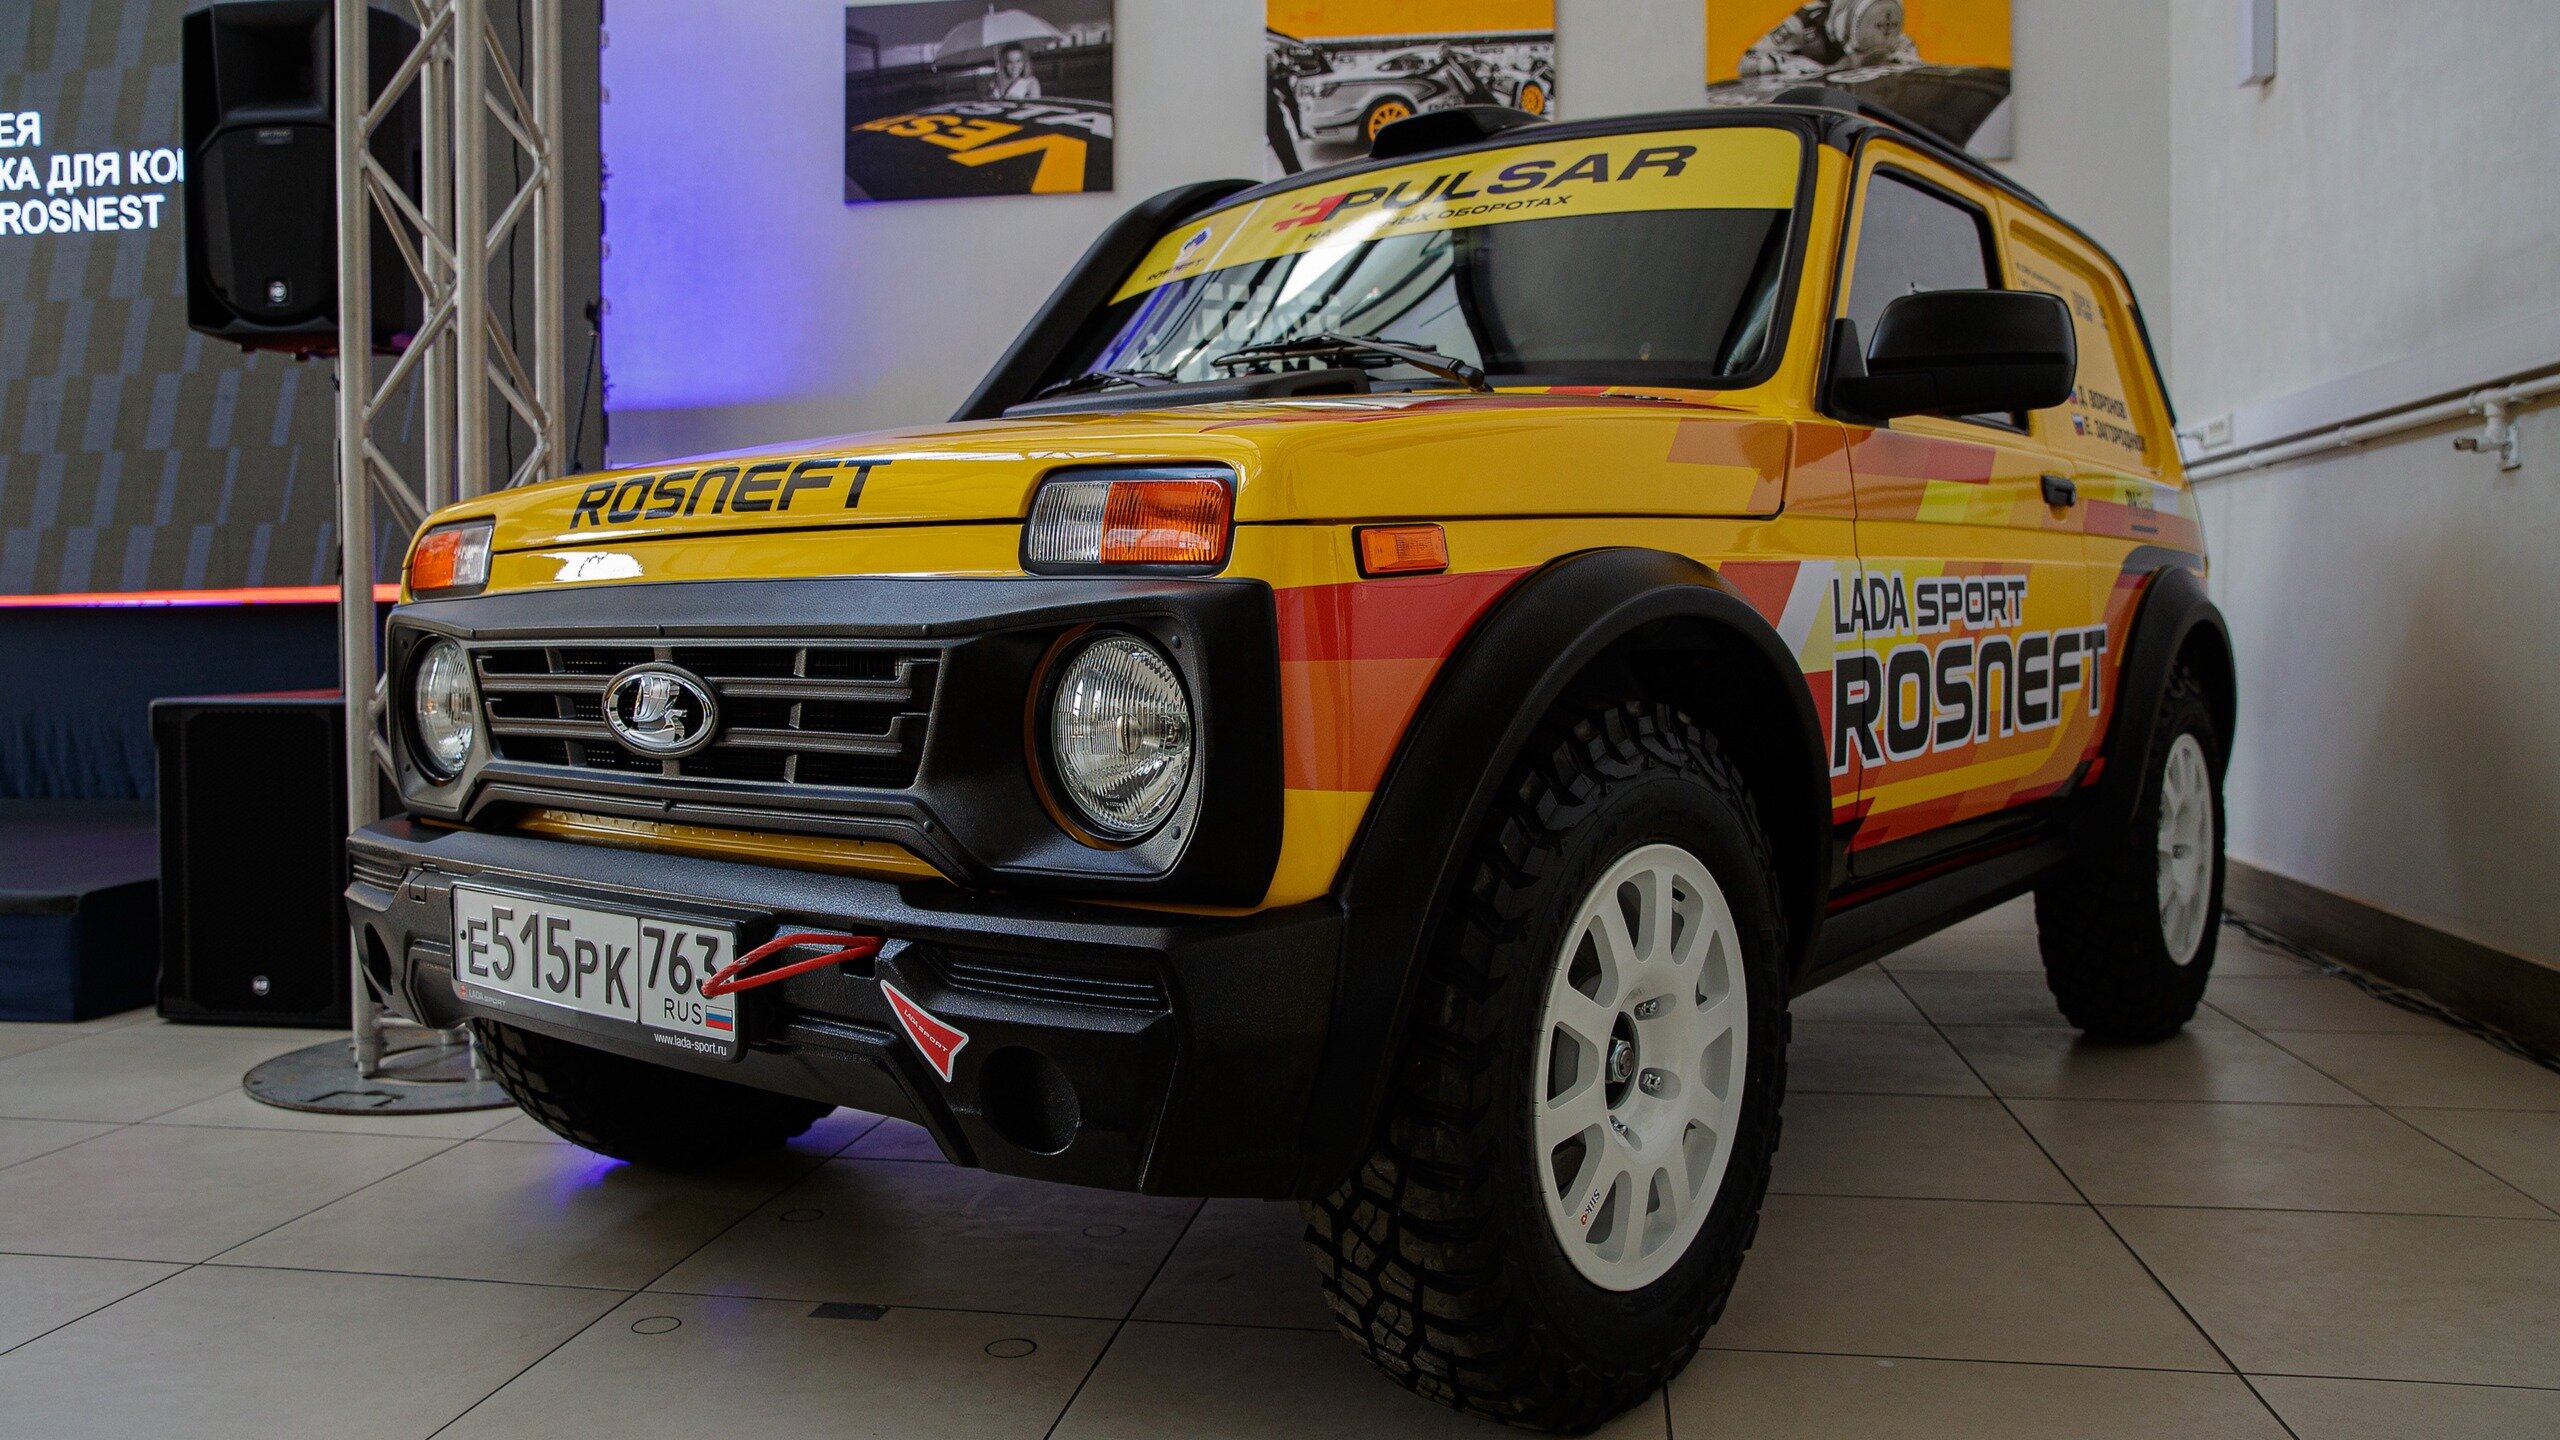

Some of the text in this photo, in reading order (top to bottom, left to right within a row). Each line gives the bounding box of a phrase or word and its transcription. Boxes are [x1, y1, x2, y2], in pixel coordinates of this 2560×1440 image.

[46, 151, 120, 196] ДЛЯ
[1324, 145, 1697, 221] PULSAR
[0, 193, 165, 235] ROSNEST
[1437, 194, 1574, 219] ОБОРОТАХ
[569, 458, 894, 529] ROSNEFT
[1831, 573, 2027, 638] LADA SPORT
[1831, 626, 2107, 773] ROSNEFT
[642, 926, 718, 998] 763
[664, 998, 703, 1025] RUS
[903, 1009, 948, 1052] LADA SPORT
[654, 1033, 727, 1056] www.lada-sport.ru
